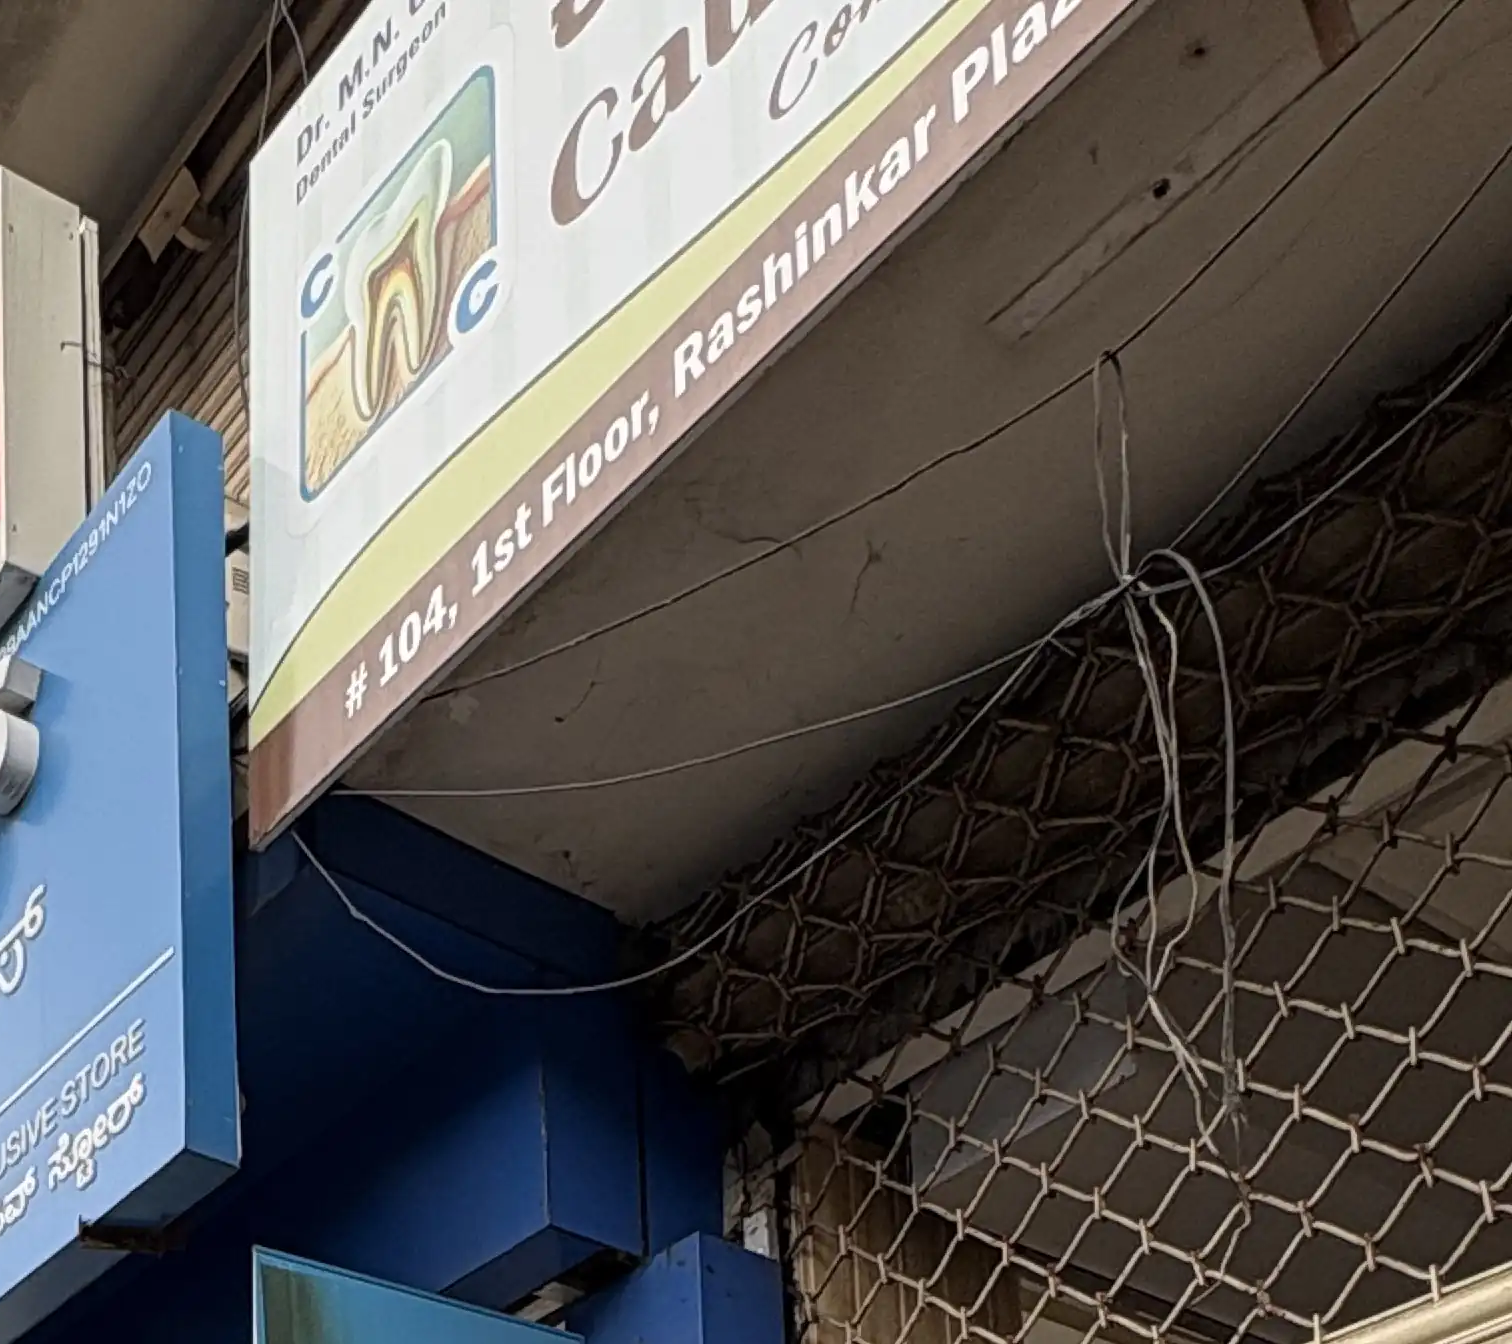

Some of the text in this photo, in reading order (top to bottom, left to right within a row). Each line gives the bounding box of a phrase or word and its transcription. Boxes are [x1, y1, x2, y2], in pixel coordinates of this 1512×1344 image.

[296, 17, 400, 167] Dr. M.N.
[296, 5, 446, 206] Dental Surgeon
[344, 664, 370, 718] #
[379, 583, 459, 690] 104,
[469, 508, 534, 602] 1st
[539, 401, 659, 528] Floor,
[672, 105, 937, 398] Rashinkar
[61, 1018, 146, 1118] STORE
